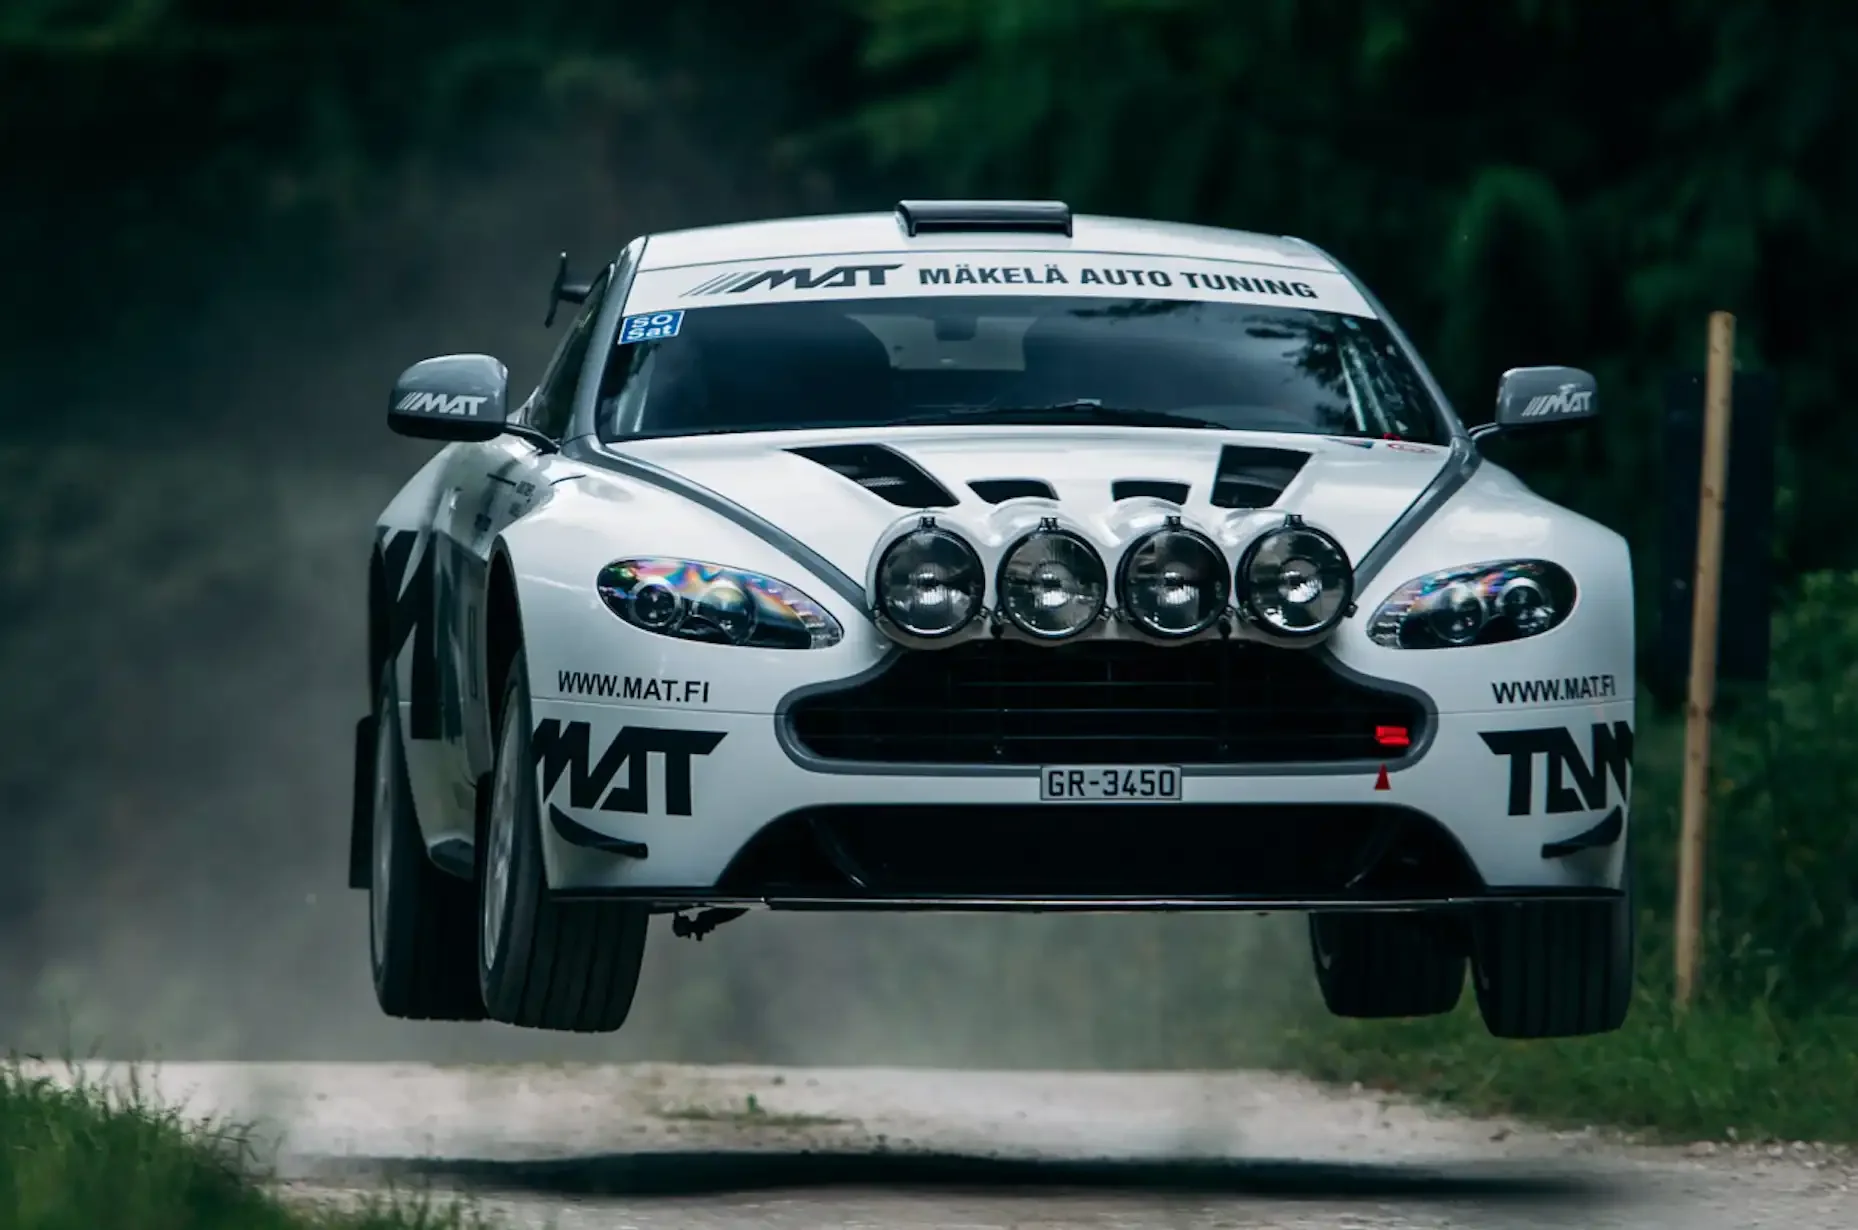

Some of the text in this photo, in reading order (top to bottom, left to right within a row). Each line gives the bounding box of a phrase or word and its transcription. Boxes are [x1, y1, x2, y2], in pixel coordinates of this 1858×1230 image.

[725, 264, 1319, 299] MAT MÄKELÄ AUTO TUNING
[626, 325, 673, 340] Sat
[409, 393, 489, 416] MAT
[558, 670, 709, 703] WWW.MAT.FI
[1491, 674, 1617, 704] WWW.MAT.FI
[532, 717, 730, 817] MAT
[1048, 769, 1175, 797] GR-3450
